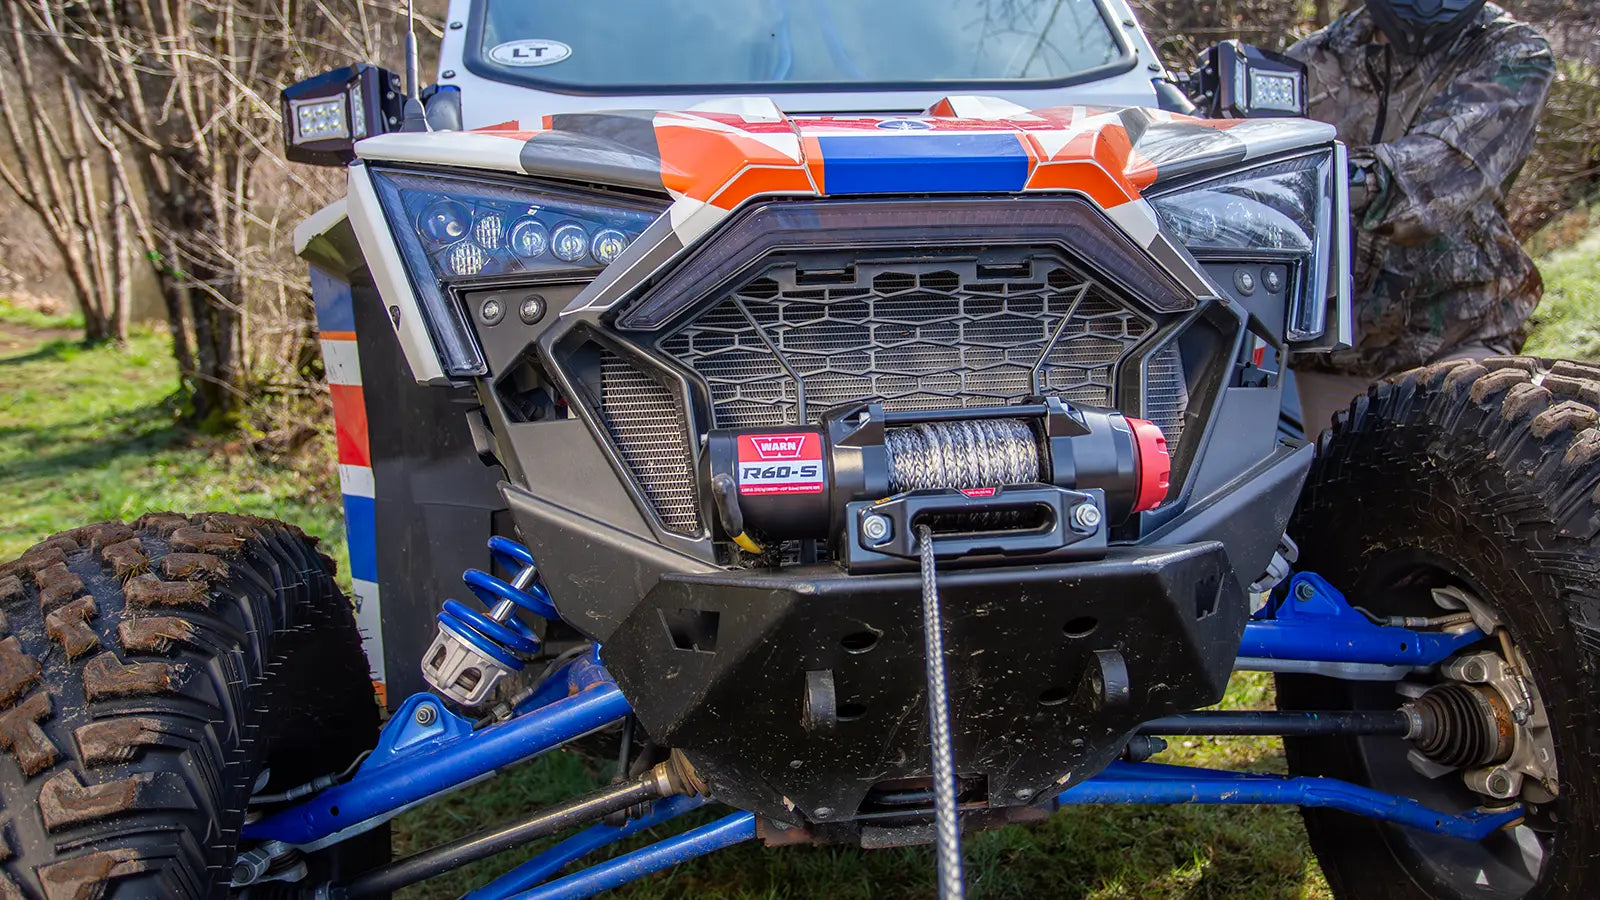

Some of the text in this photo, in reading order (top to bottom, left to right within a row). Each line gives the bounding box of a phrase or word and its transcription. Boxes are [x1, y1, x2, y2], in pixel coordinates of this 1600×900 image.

[512, 47, 549, 58] LT
[760, 442, 797, 452] WARN
[743, 465, 818, 480] R60-S
